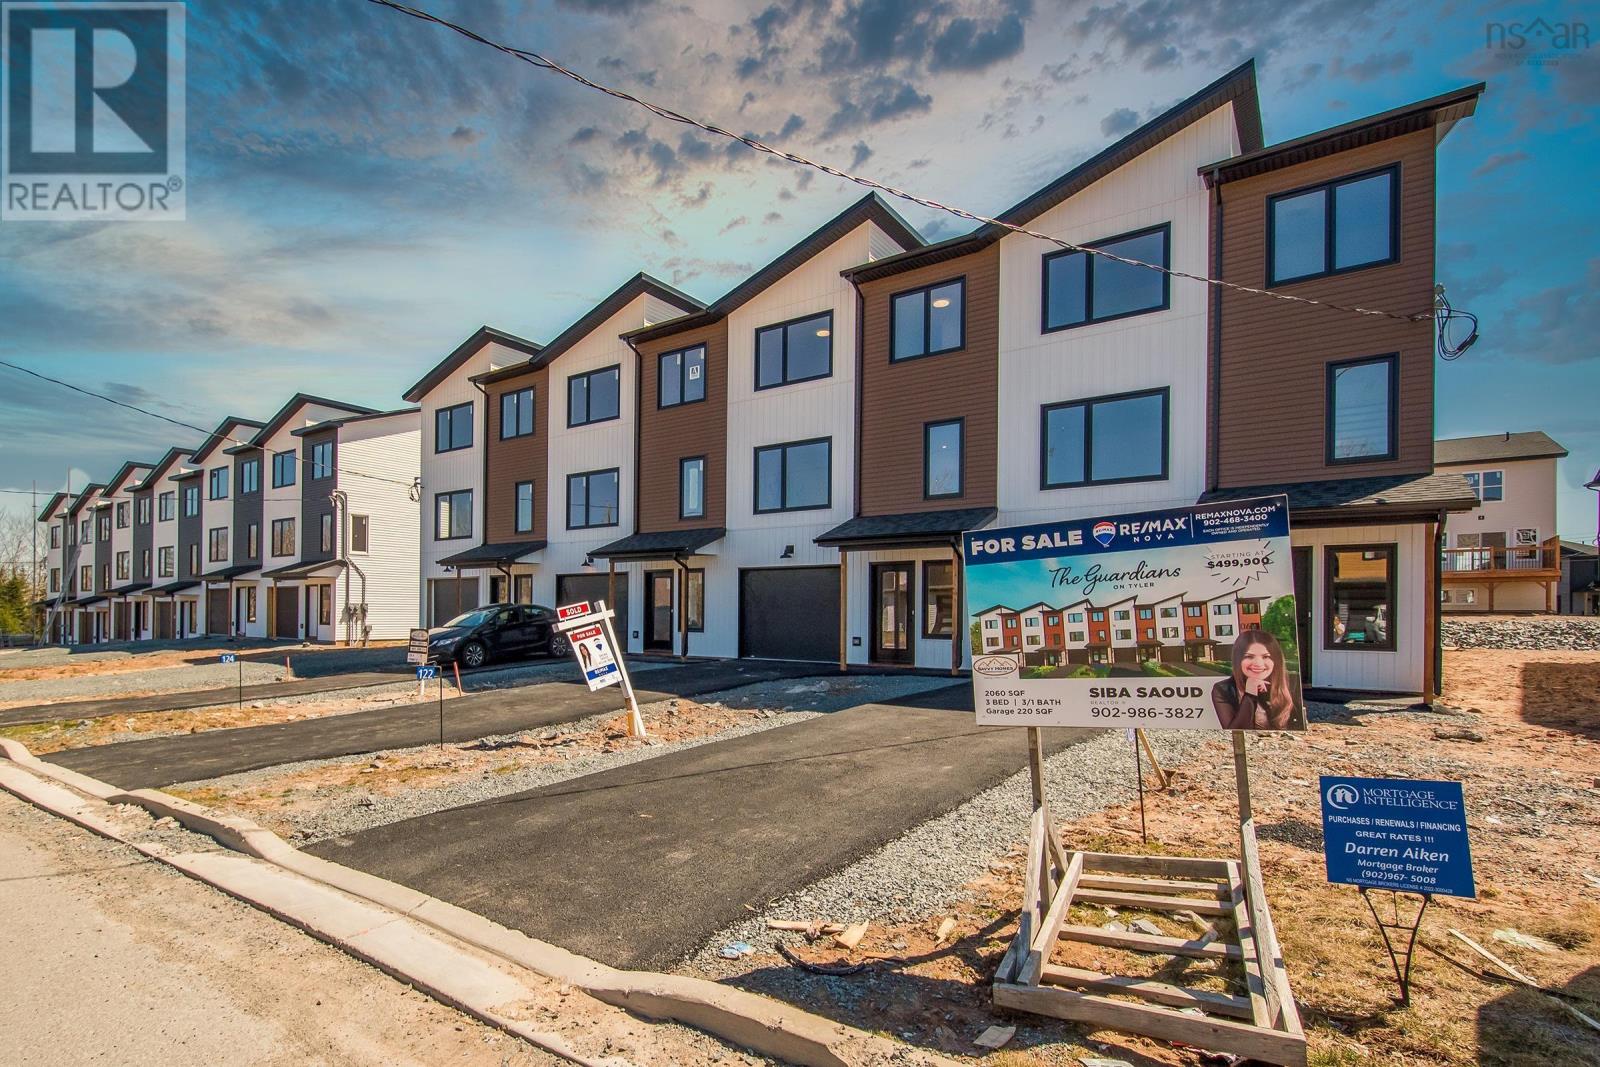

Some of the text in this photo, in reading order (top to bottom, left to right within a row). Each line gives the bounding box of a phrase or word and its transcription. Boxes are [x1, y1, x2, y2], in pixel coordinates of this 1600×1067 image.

[1195, 505, 1276, 520] REMAXNOVA.COM
[1119, 517, 1187, 535] RE/MAX
[1203, 513, 1268, 526] 902-468-3400
[971, 529, 1083, 556] FOR SALE
[1133, 532, 1175, 543] NOVA
[1207, 556, 1270, 569] $499,900
[1049, 560, 1181, 596] The Guardians
[1128, 581, 1155, 589] TYLER
[565, 606, 582, 616] SOLD
[222, 655, 235, 663] 124
[418, 668, 434, 679] 122
[1089, 686, 1204, 698] SIBA SAOUD
[986, 707, 1015, 715] Garage
[1091, 707, 1204, 719] 902-986-3827
[1362, 787, 1436, 801] MORTGAGE
[1363, 796, 1458, 810] INTELLIGENCE
[1328, 815, 1371, 826] PURCHASES
[1375, 818, 1415, 829] RENEWALS
[1420, 821, 1461, 832] FINANCING
[1355, 830, 1387, 840] GREAT
[1389, 833, 1422, 842] RATES
[1344, 842, 1449, 863] Darren Aiken
[1357, 859, 1439, 874] Mortgage Broker
[1410, 875, 1437, 884] 5008
